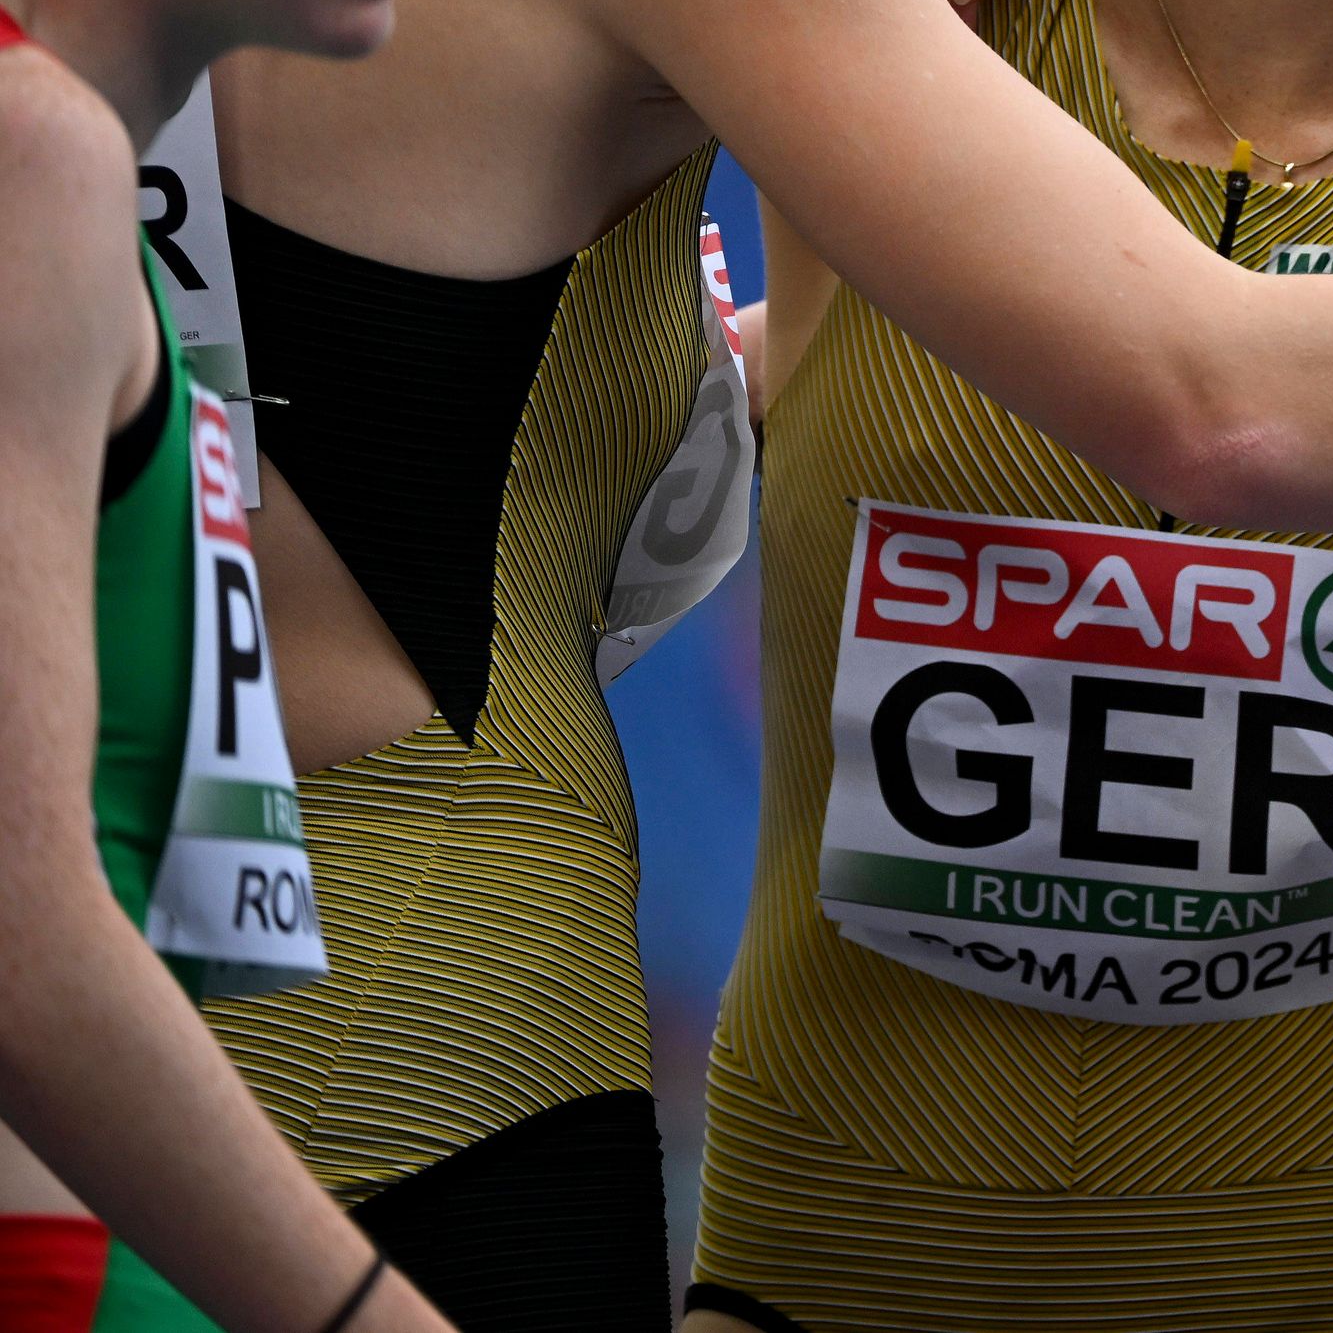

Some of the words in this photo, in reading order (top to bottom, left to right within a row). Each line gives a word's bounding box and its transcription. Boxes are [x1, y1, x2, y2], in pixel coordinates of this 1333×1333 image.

[873, 532, 1277, 659] SPAR
[944, 871, 958, 911] I
[971, 875, 1088, 925] RUN
